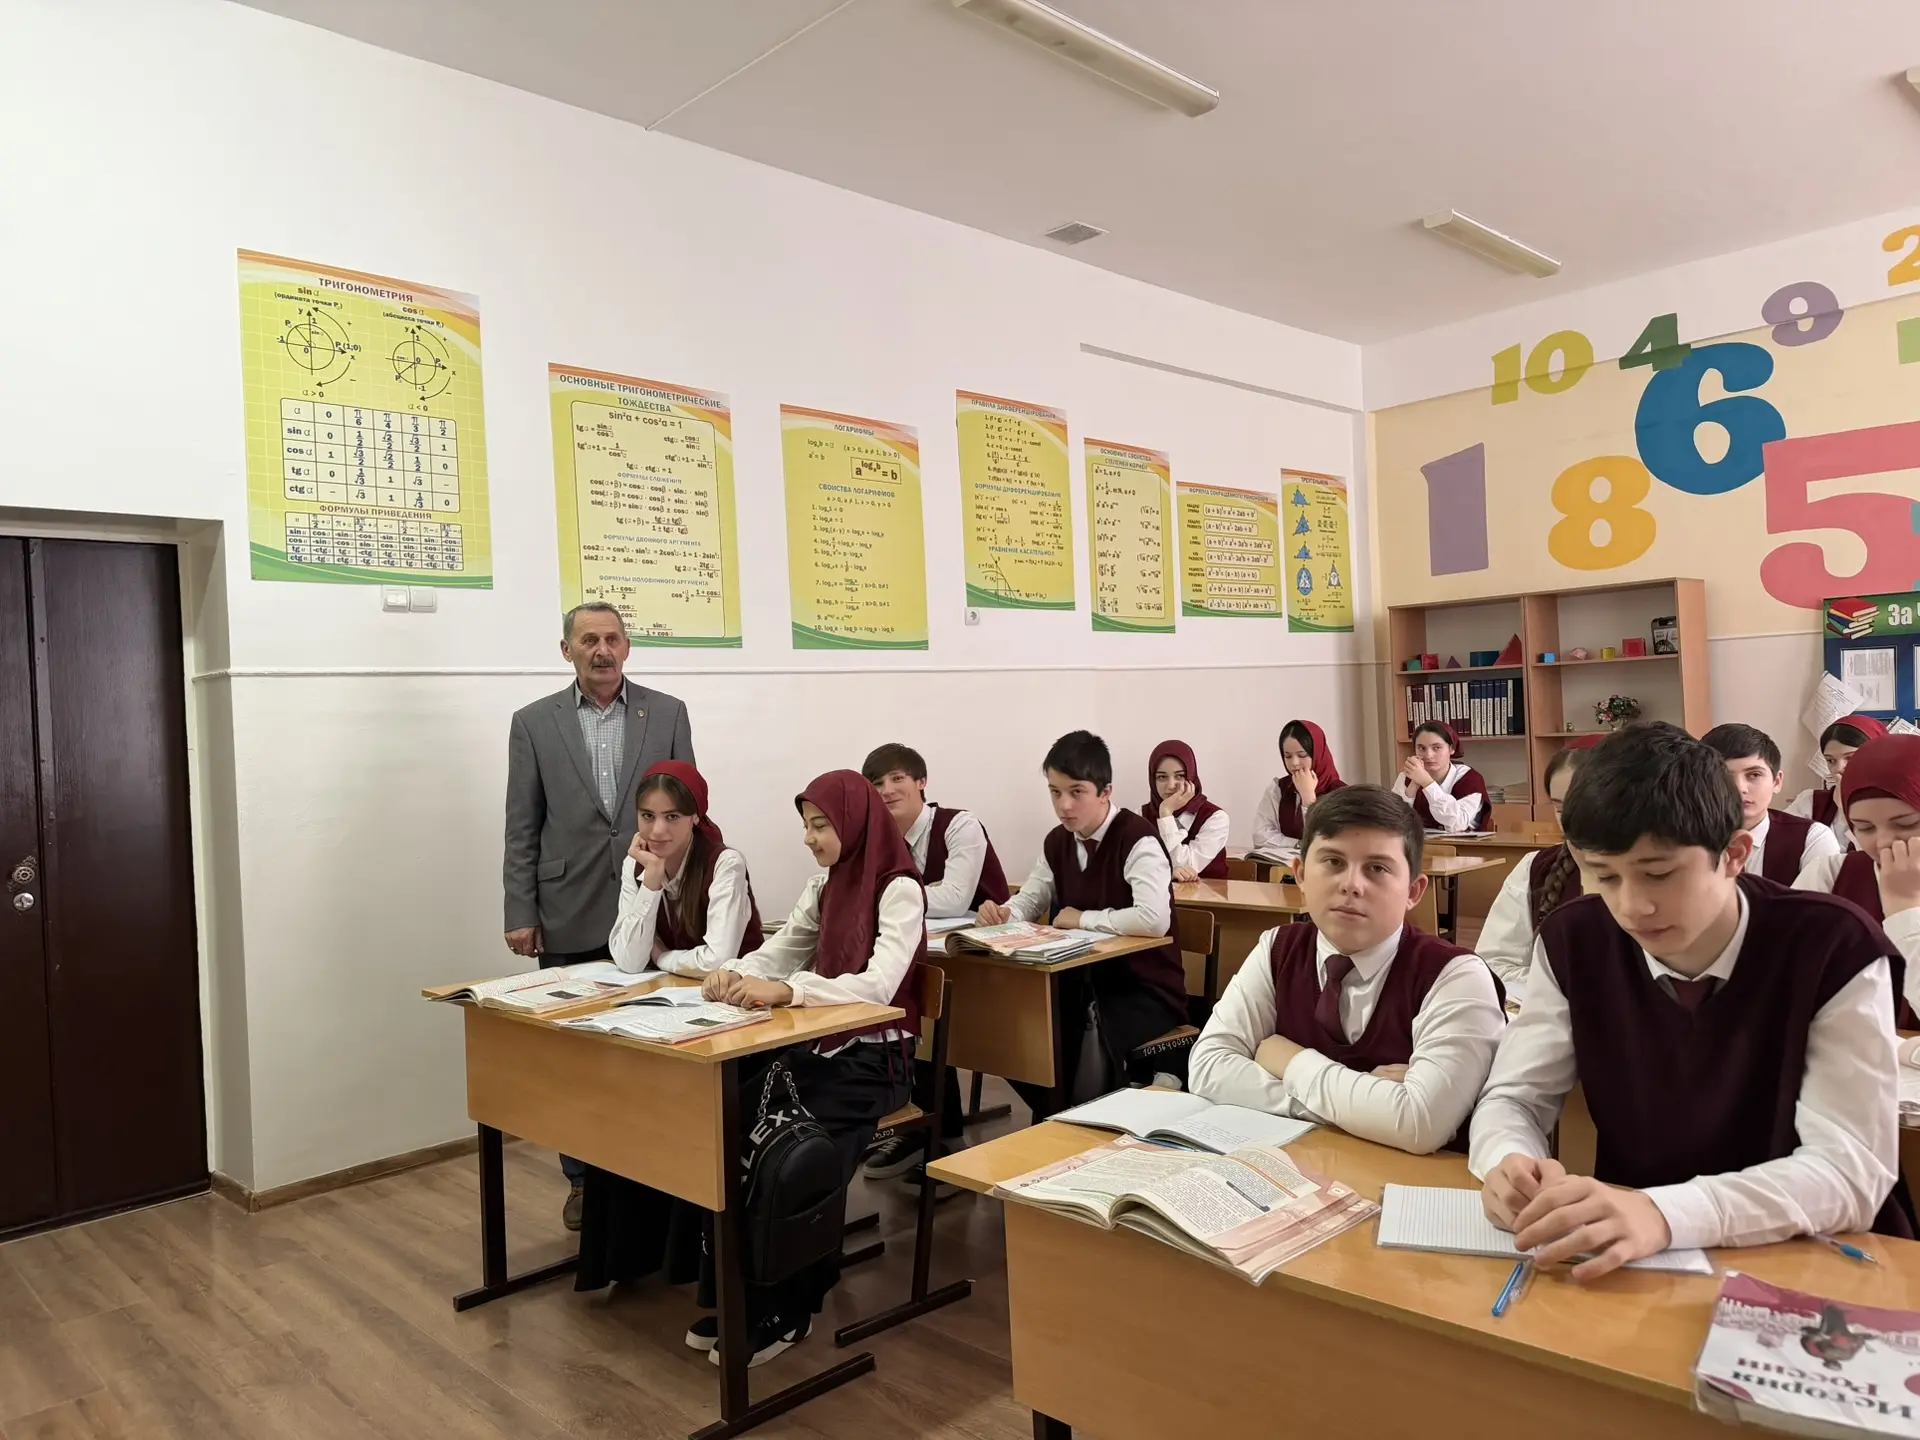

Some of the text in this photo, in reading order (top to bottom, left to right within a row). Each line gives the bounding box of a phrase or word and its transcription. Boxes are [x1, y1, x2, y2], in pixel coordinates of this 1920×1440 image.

[297, 287, 312, 295] sin
[318, 278, 413, 302] ТРИГОНОМЕТРИЯ
[1761, 282, 1844, 346] 9
[1619, 313, 1692, 371] 4
[1491, 330, 1594, 405] 10
[560, 375, 721, 408] ОСНОВНЫЕ ТРИГОНОМЕТРИЧЕСКИЕ
[618, 397, 671, 413] ТОЖДЕСТВА
[678, 421, 682, 429] 1
[1635, 342, 1786, 495] 6
[287, 427, 302, 435] sin
[834, 424, 875, 436] ЛОГАРИФМЫ
[287, 446, 304, 455] cos
[291, 467, 302, 476] tg
[329, 470, 335, 478] 0
[891, 470, 897, 480] b
[290, 485, 305, 494] ctg
[319, 505, 432, 520] ФОРМУЛЫ ПРИВЕДЕНИЯ
[1421, 443, 1489, 576] 1
[1548, 455, 1656, 571] 8
[1760, 421, 1920, 610] 5
[1736, 1357, 1879, 1397] России
[1731, 1370, 1913, 1418] История
